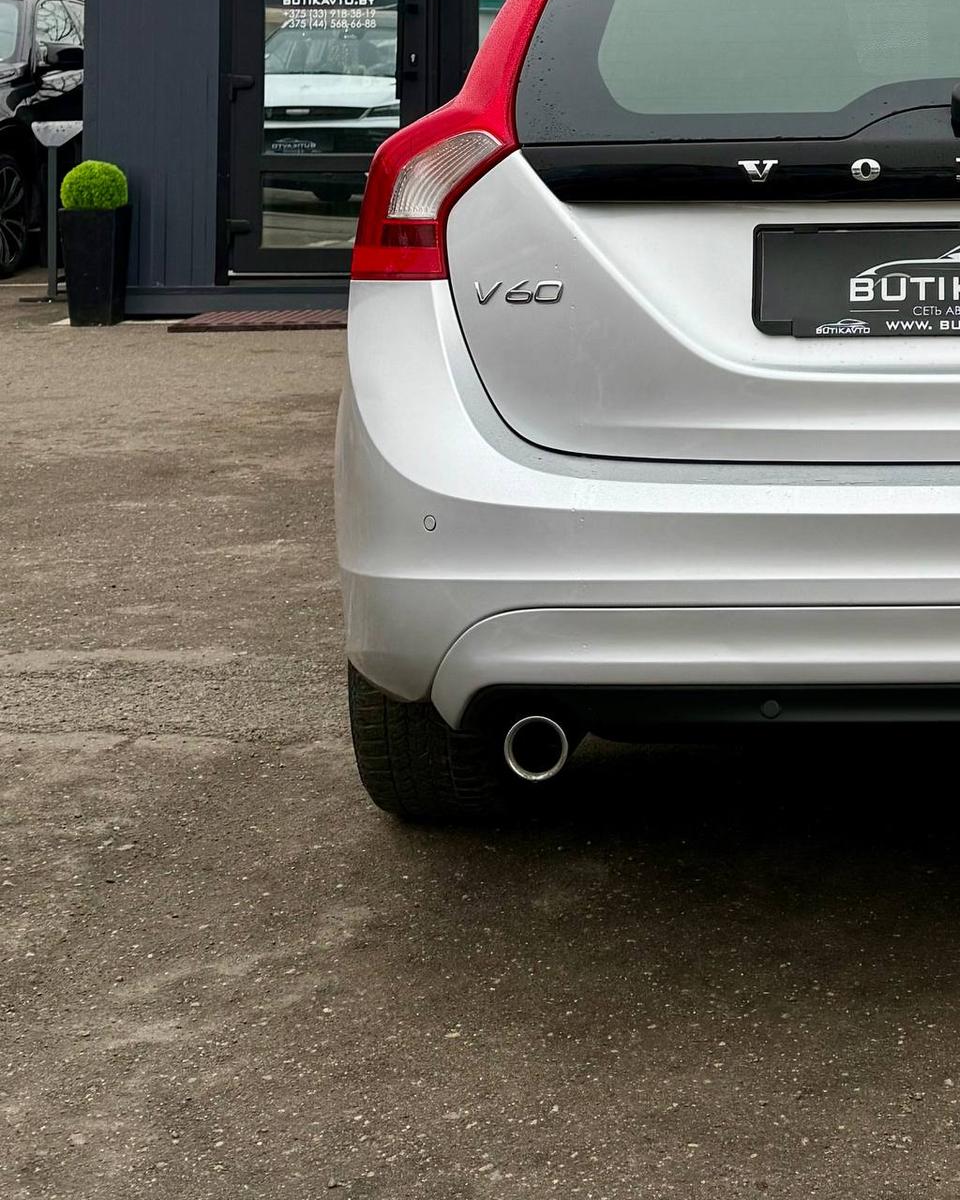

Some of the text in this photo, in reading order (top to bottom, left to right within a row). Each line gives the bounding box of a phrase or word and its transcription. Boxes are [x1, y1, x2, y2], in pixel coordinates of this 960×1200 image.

[283, 9, 376, 20] +375 (33) 918-38-19
[309, 19, 327, 30] (44)
[330, 19, 376, 29] 568-66-88
[474, 280, 564, 305] V60
[912, 305, 942, 316] СЕТЬ
[815, 326, 870, 334] BUTIKAVTO
